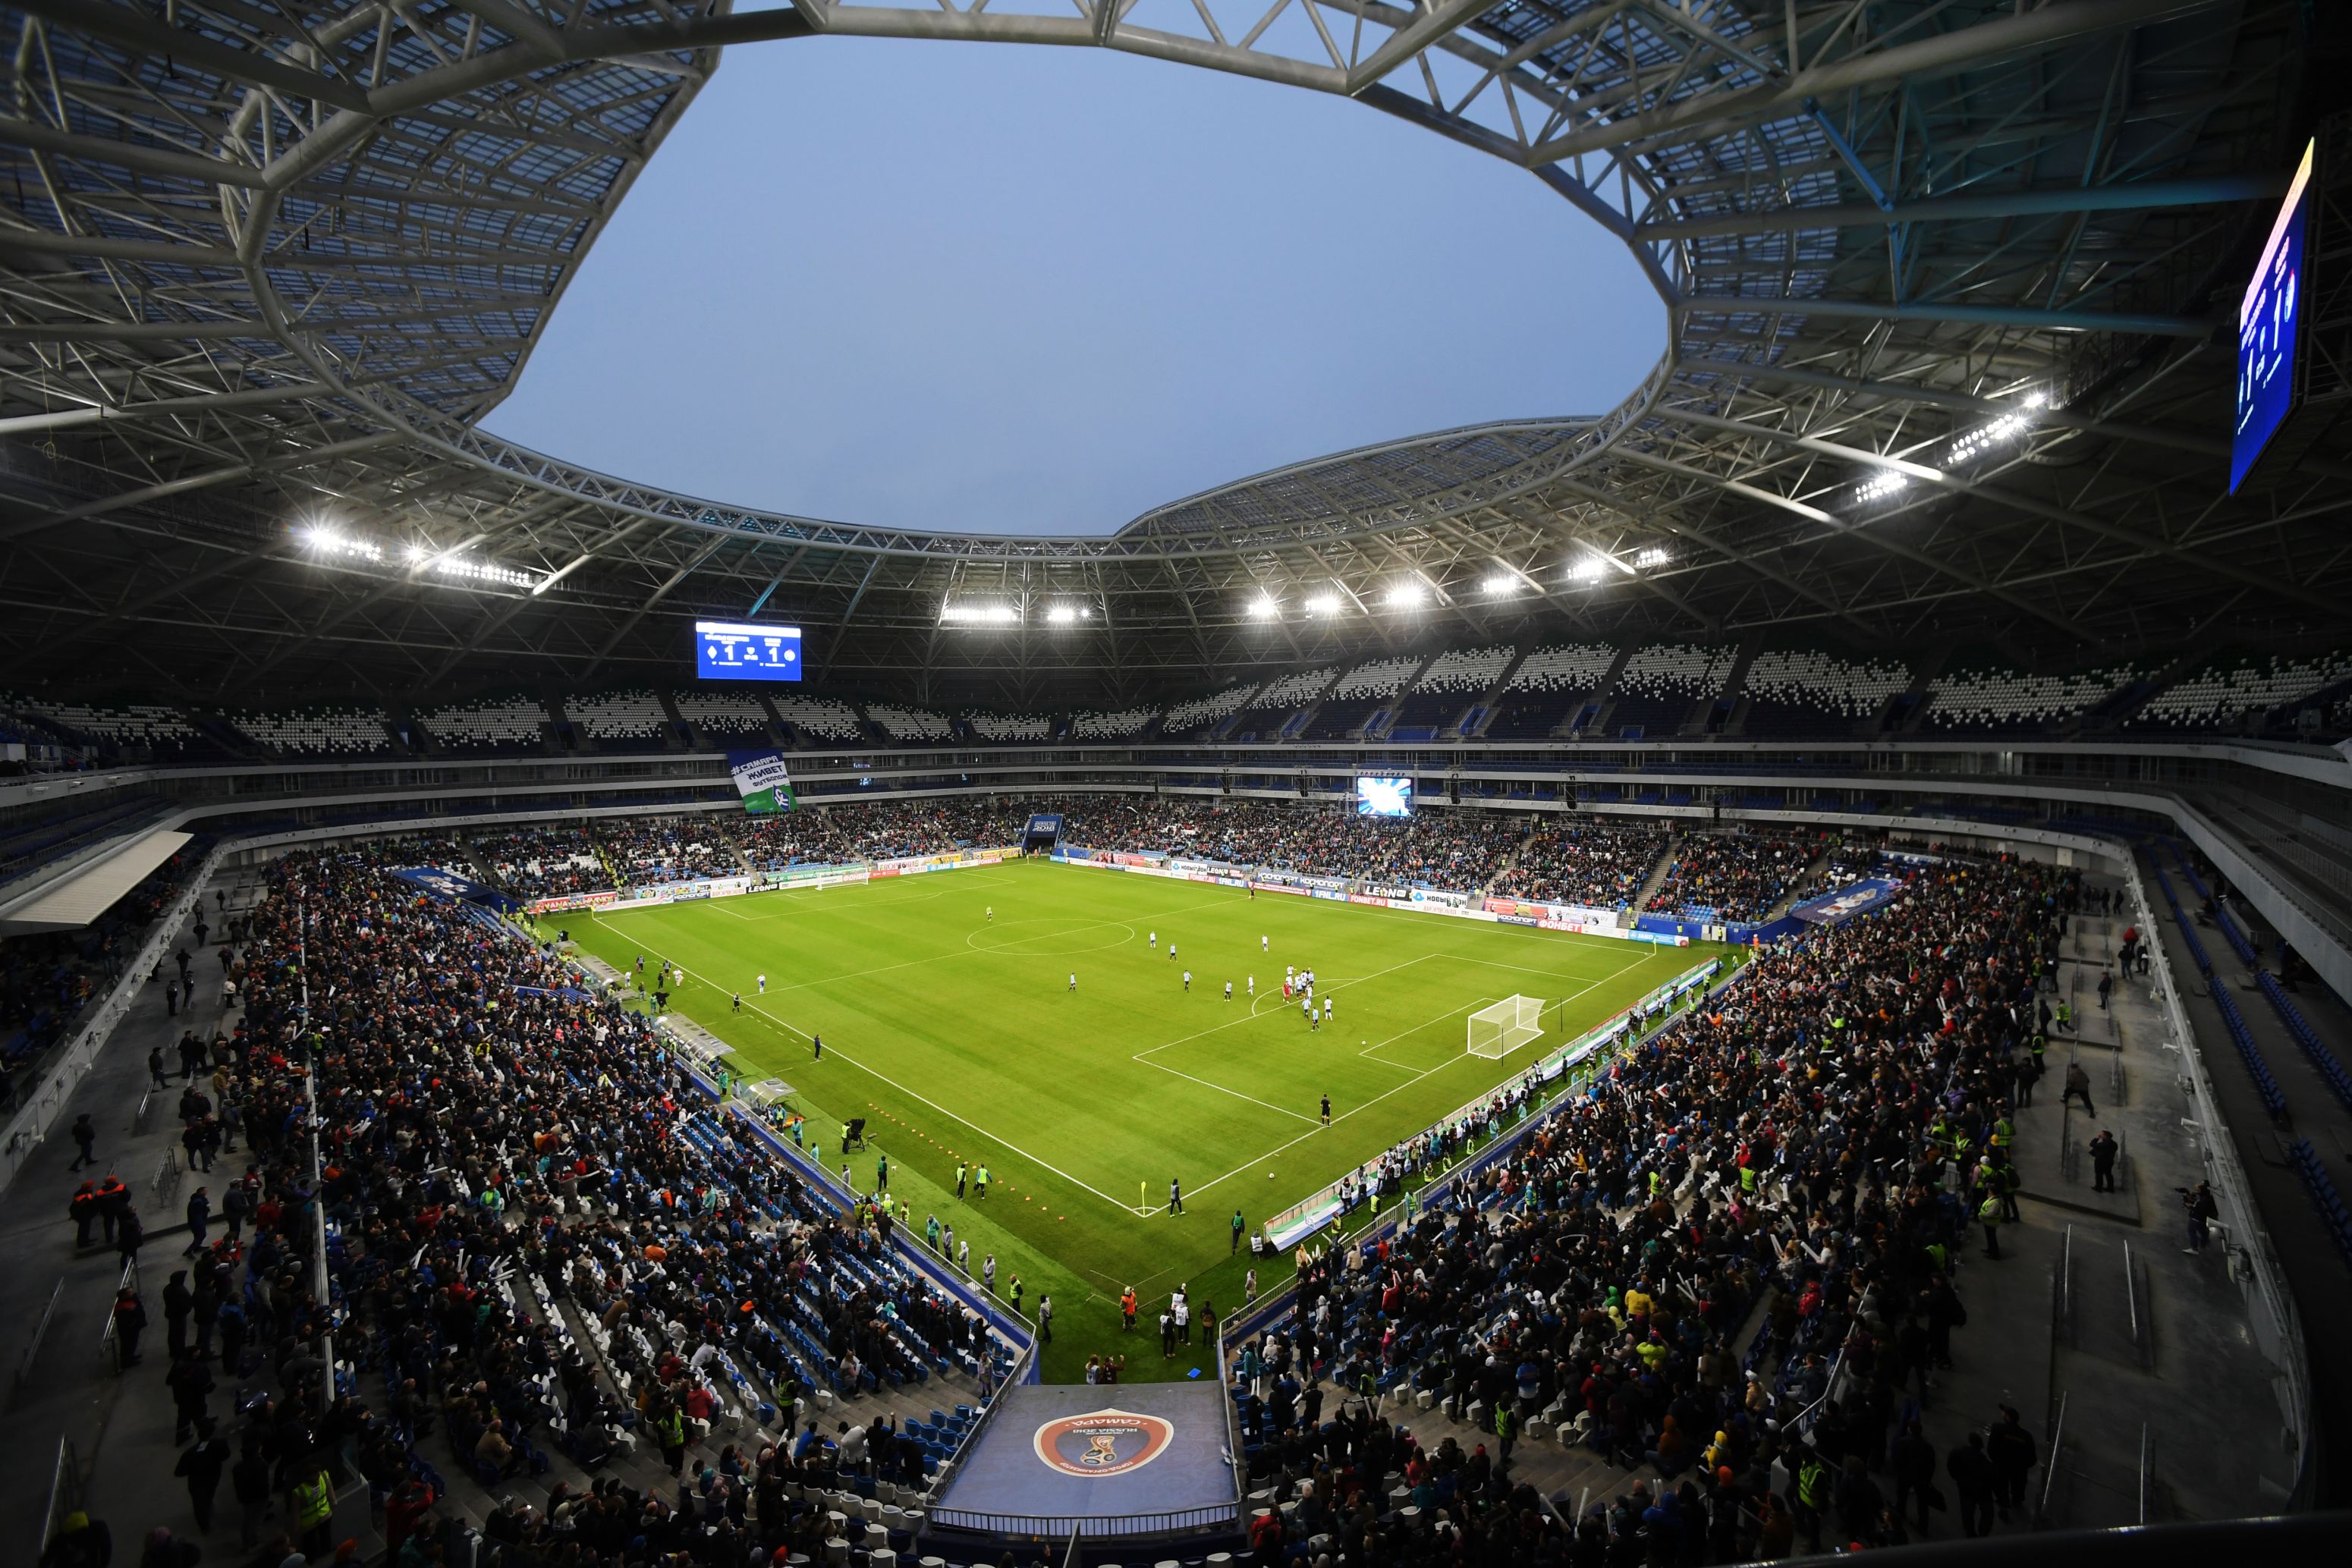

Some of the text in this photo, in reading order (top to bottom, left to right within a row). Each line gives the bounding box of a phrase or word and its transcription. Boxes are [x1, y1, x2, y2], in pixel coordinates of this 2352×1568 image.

[725, 645, 734, 661] 1
[769, 647, 778, 662] 1
[731, 756, 779, 775] #САМАРА
[747, 765, 783, 781] ЖИВЕТ
[753, 774, 788, 787] ФУТБОЛОМ
[747, 884, 772, 893] LEON
[1350, 895, 1386, 907] FONBET.RU
[1539, 919, 1581, 932] ФОНБЕТ
[1071, 1418, 1142, 1426] САМАРА
